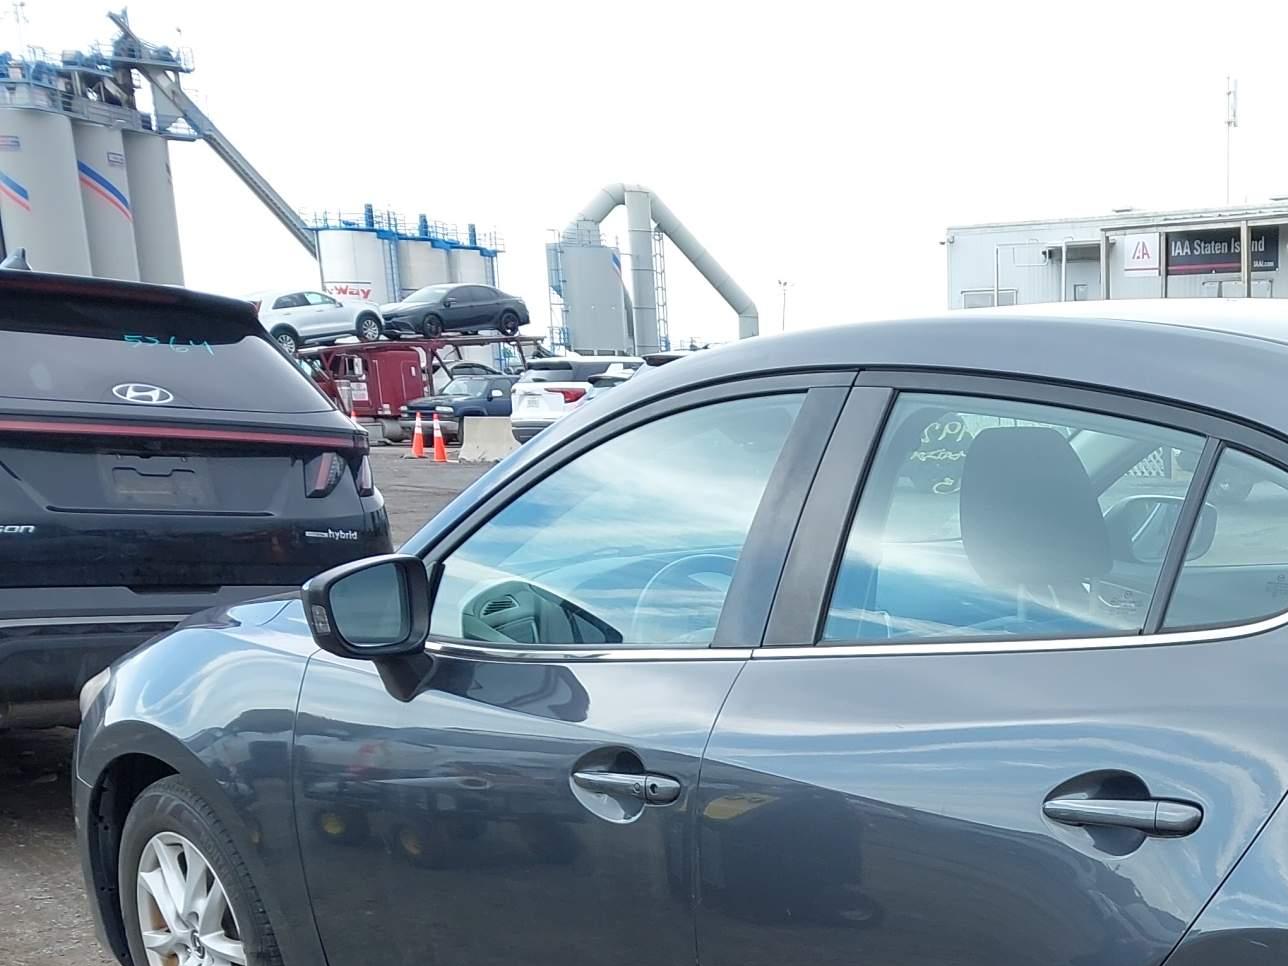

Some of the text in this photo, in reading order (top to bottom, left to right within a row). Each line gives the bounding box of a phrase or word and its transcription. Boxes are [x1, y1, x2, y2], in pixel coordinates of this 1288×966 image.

[1171, 236, 1265, 257] IAA Staten Isnd
[327, 528, 358, 541] hybrid
